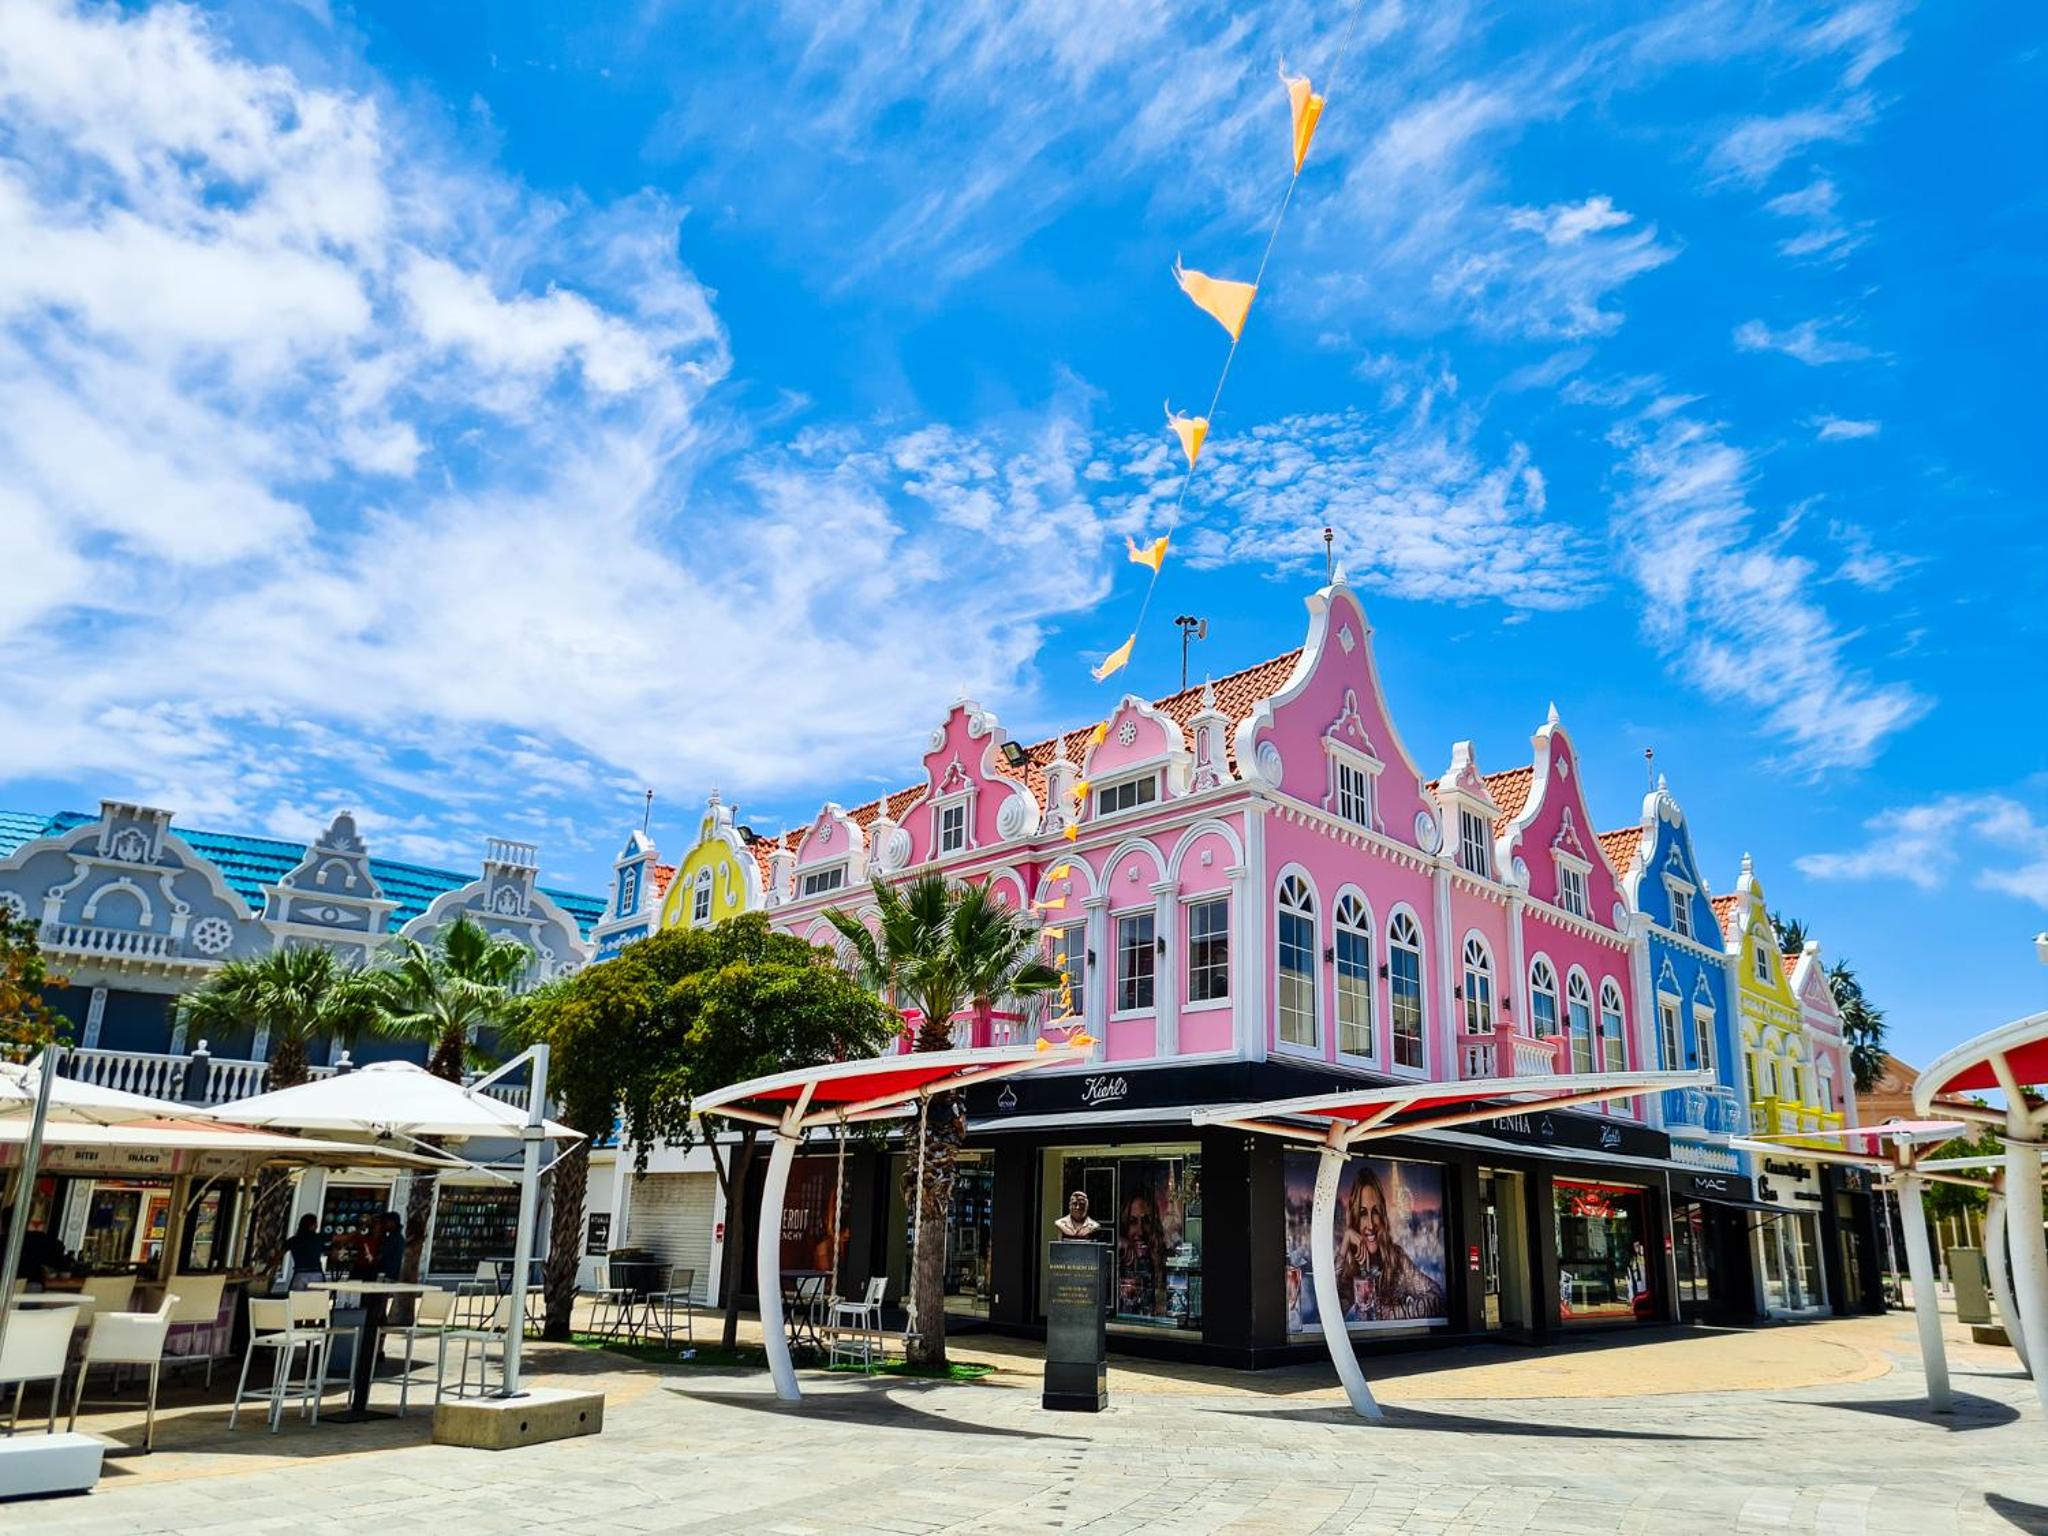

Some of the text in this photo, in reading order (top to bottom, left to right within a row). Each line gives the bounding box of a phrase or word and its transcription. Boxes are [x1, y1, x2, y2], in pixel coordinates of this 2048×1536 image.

[1081, 1076, 1128, 1106] Kiehl's
[1492, 1113, 1532, 1135] PENHA
[1694, 1177, 1728, 1192] MAC
